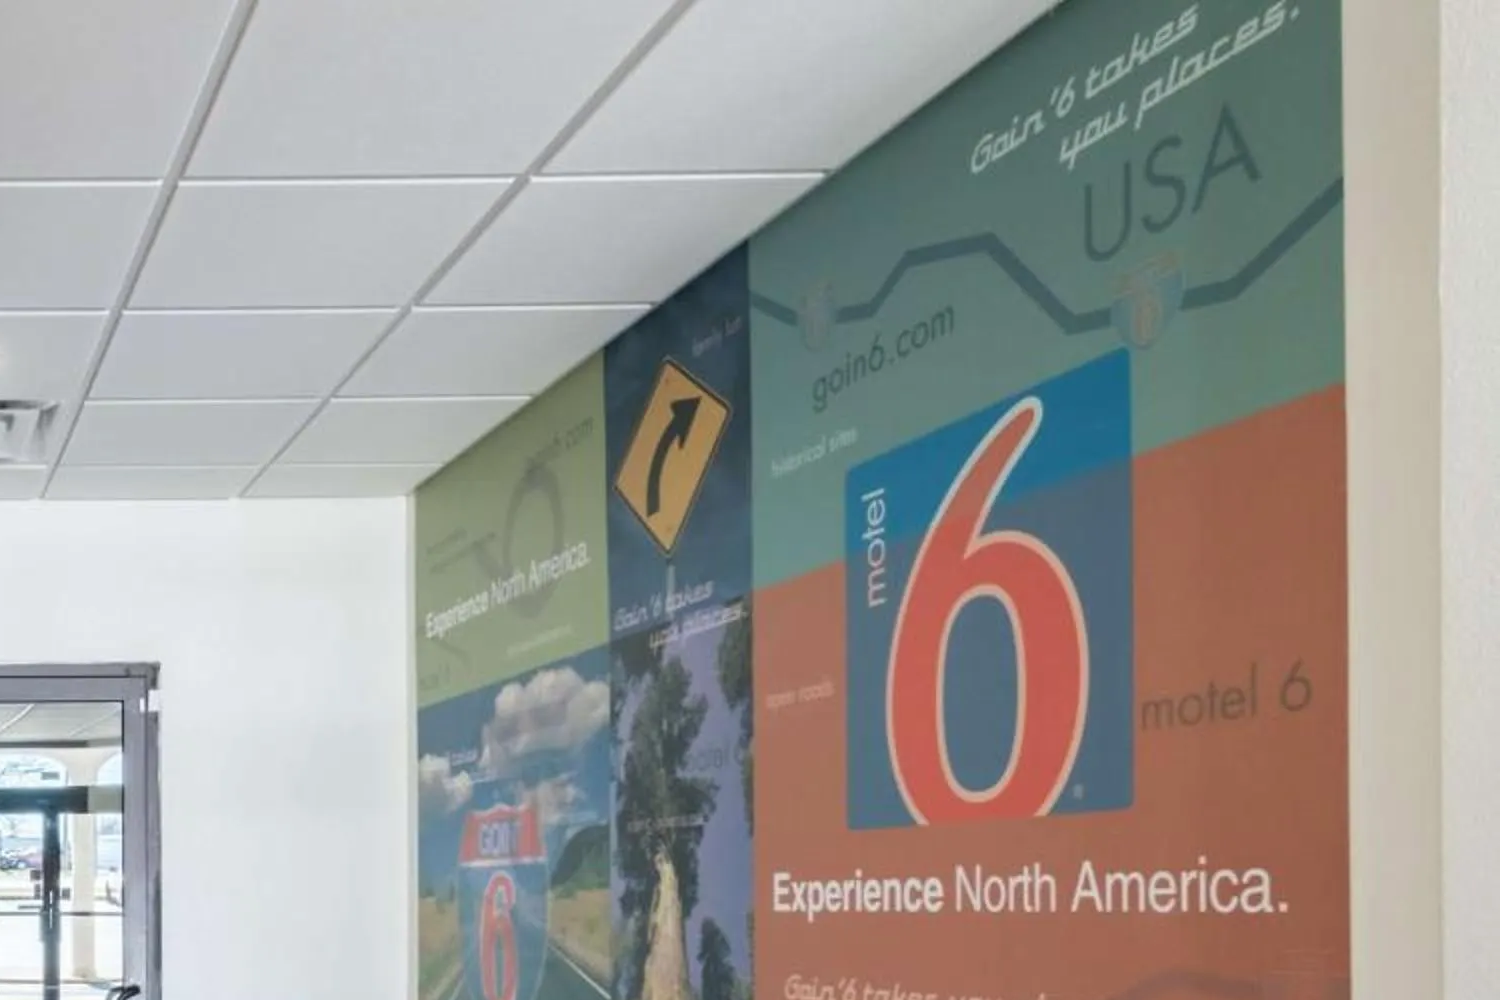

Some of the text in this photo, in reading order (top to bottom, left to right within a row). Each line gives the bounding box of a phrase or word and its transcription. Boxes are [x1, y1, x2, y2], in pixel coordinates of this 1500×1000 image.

[1059, 0, 1300, 171] you places.
[1084, 3, 1199, 99] takes
[1084, 102, 1261, 262] USA
[812, 305, 955, 415] goin6.com
[861, 487, 886, 608] motel
[425, 588, 489, 639] Experience
[490, 571, 526, 606] North
[885, 396, 1090, 826] 6
[1141, 654, 1312, 731] motel 6
[772, 855, 1290, 923] Experience North America.
